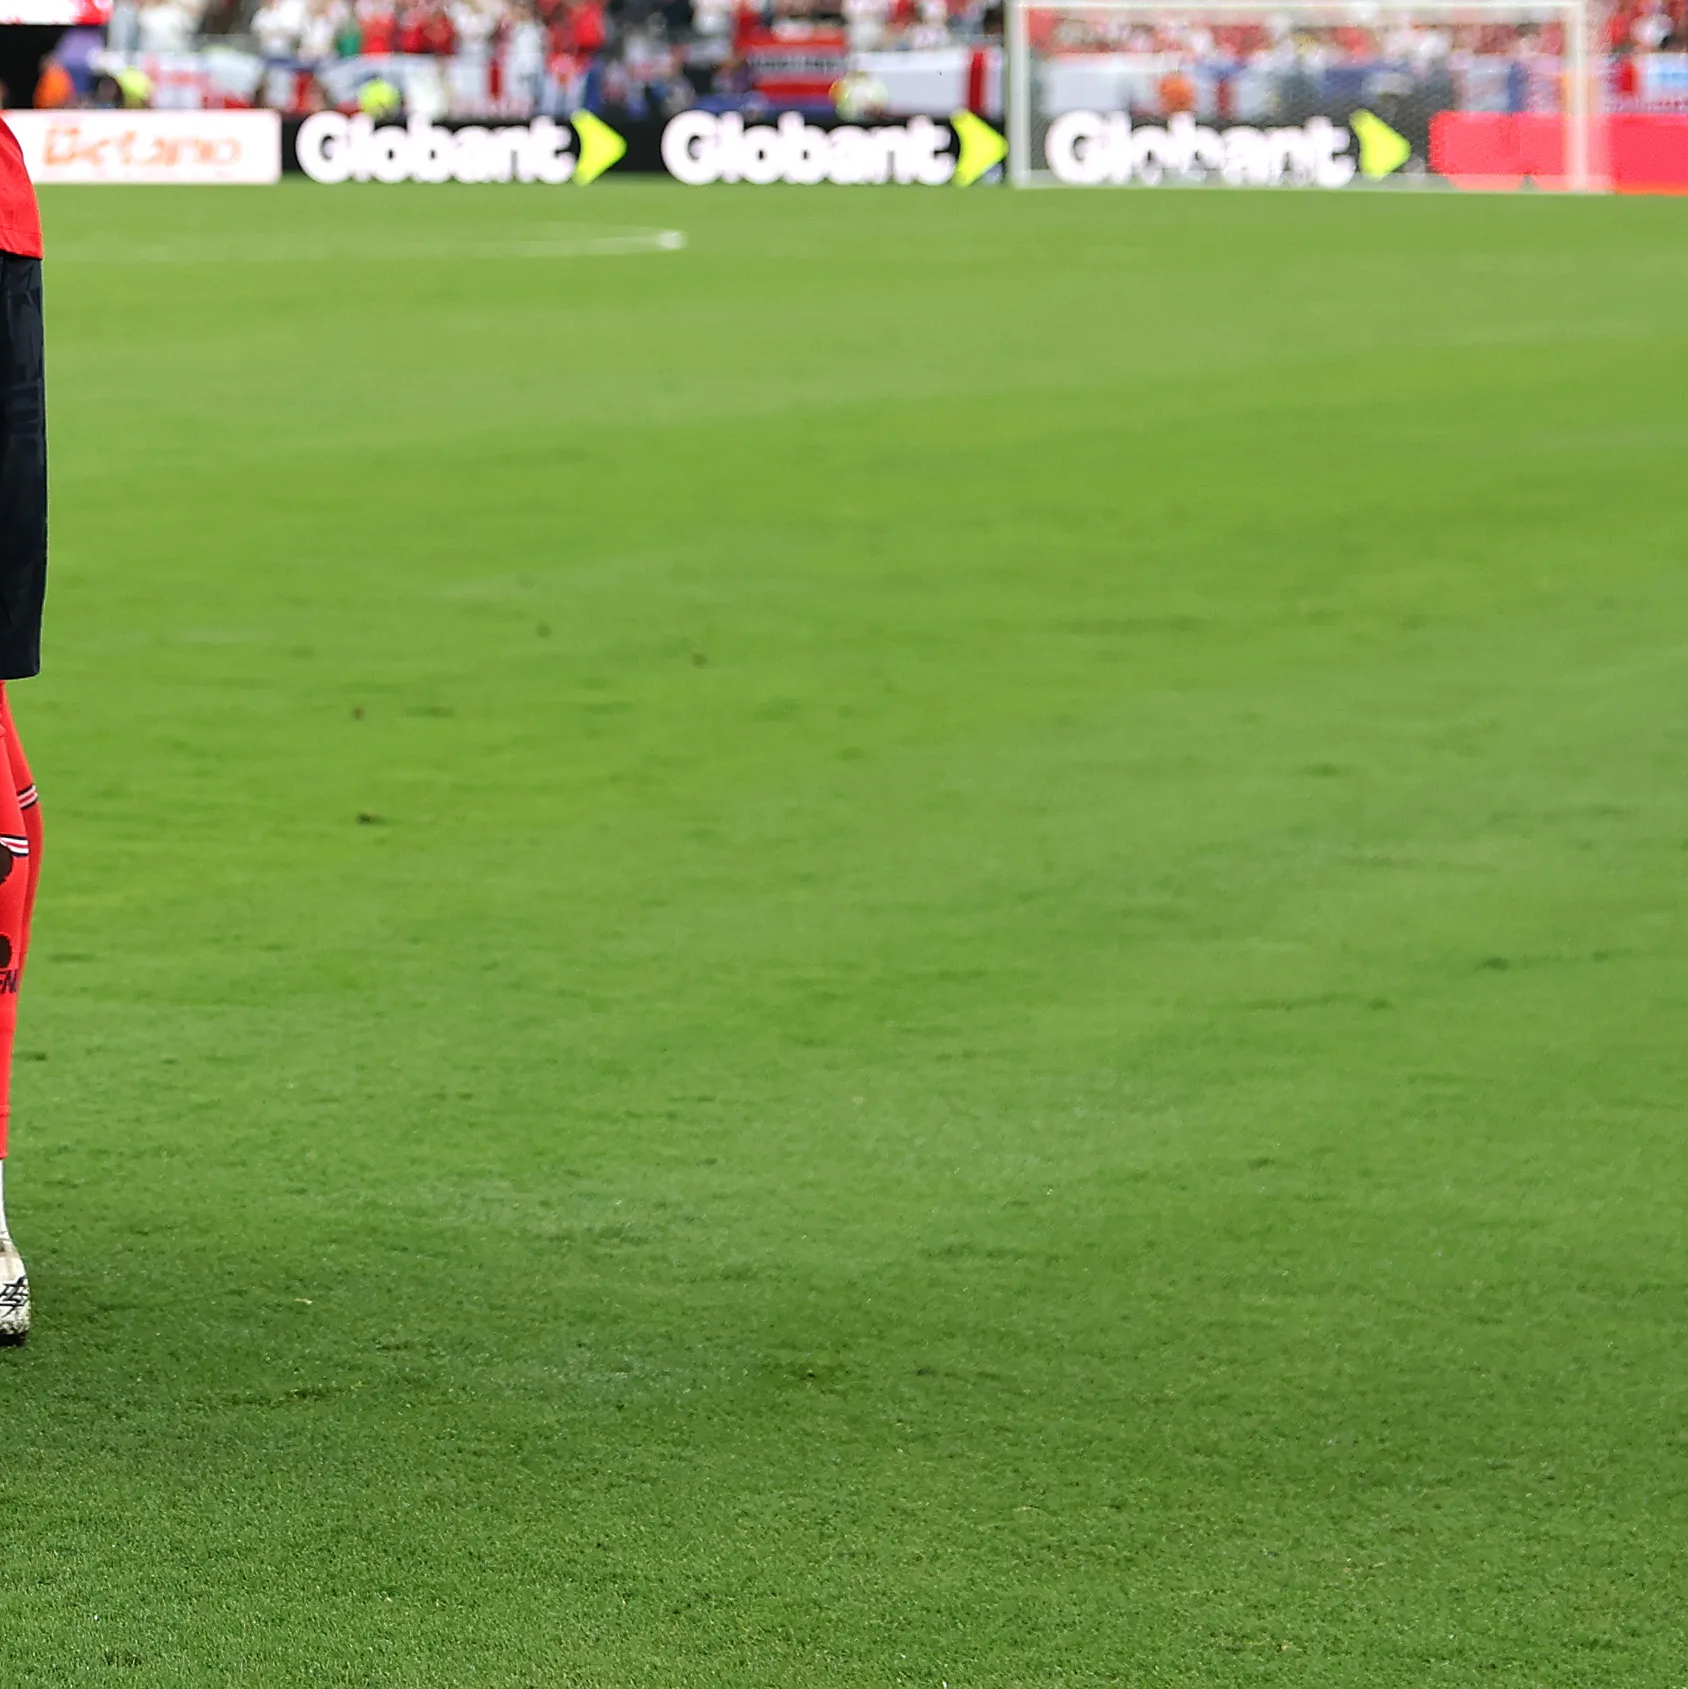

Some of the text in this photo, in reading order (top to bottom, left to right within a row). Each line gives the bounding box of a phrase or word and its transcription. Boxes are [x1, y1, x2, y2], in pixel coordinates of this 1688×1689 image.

[296, 111, 576, 183] Globant
[661, 110, 956, 185] Globant
[1044, 111, 1355, 187] Globant
